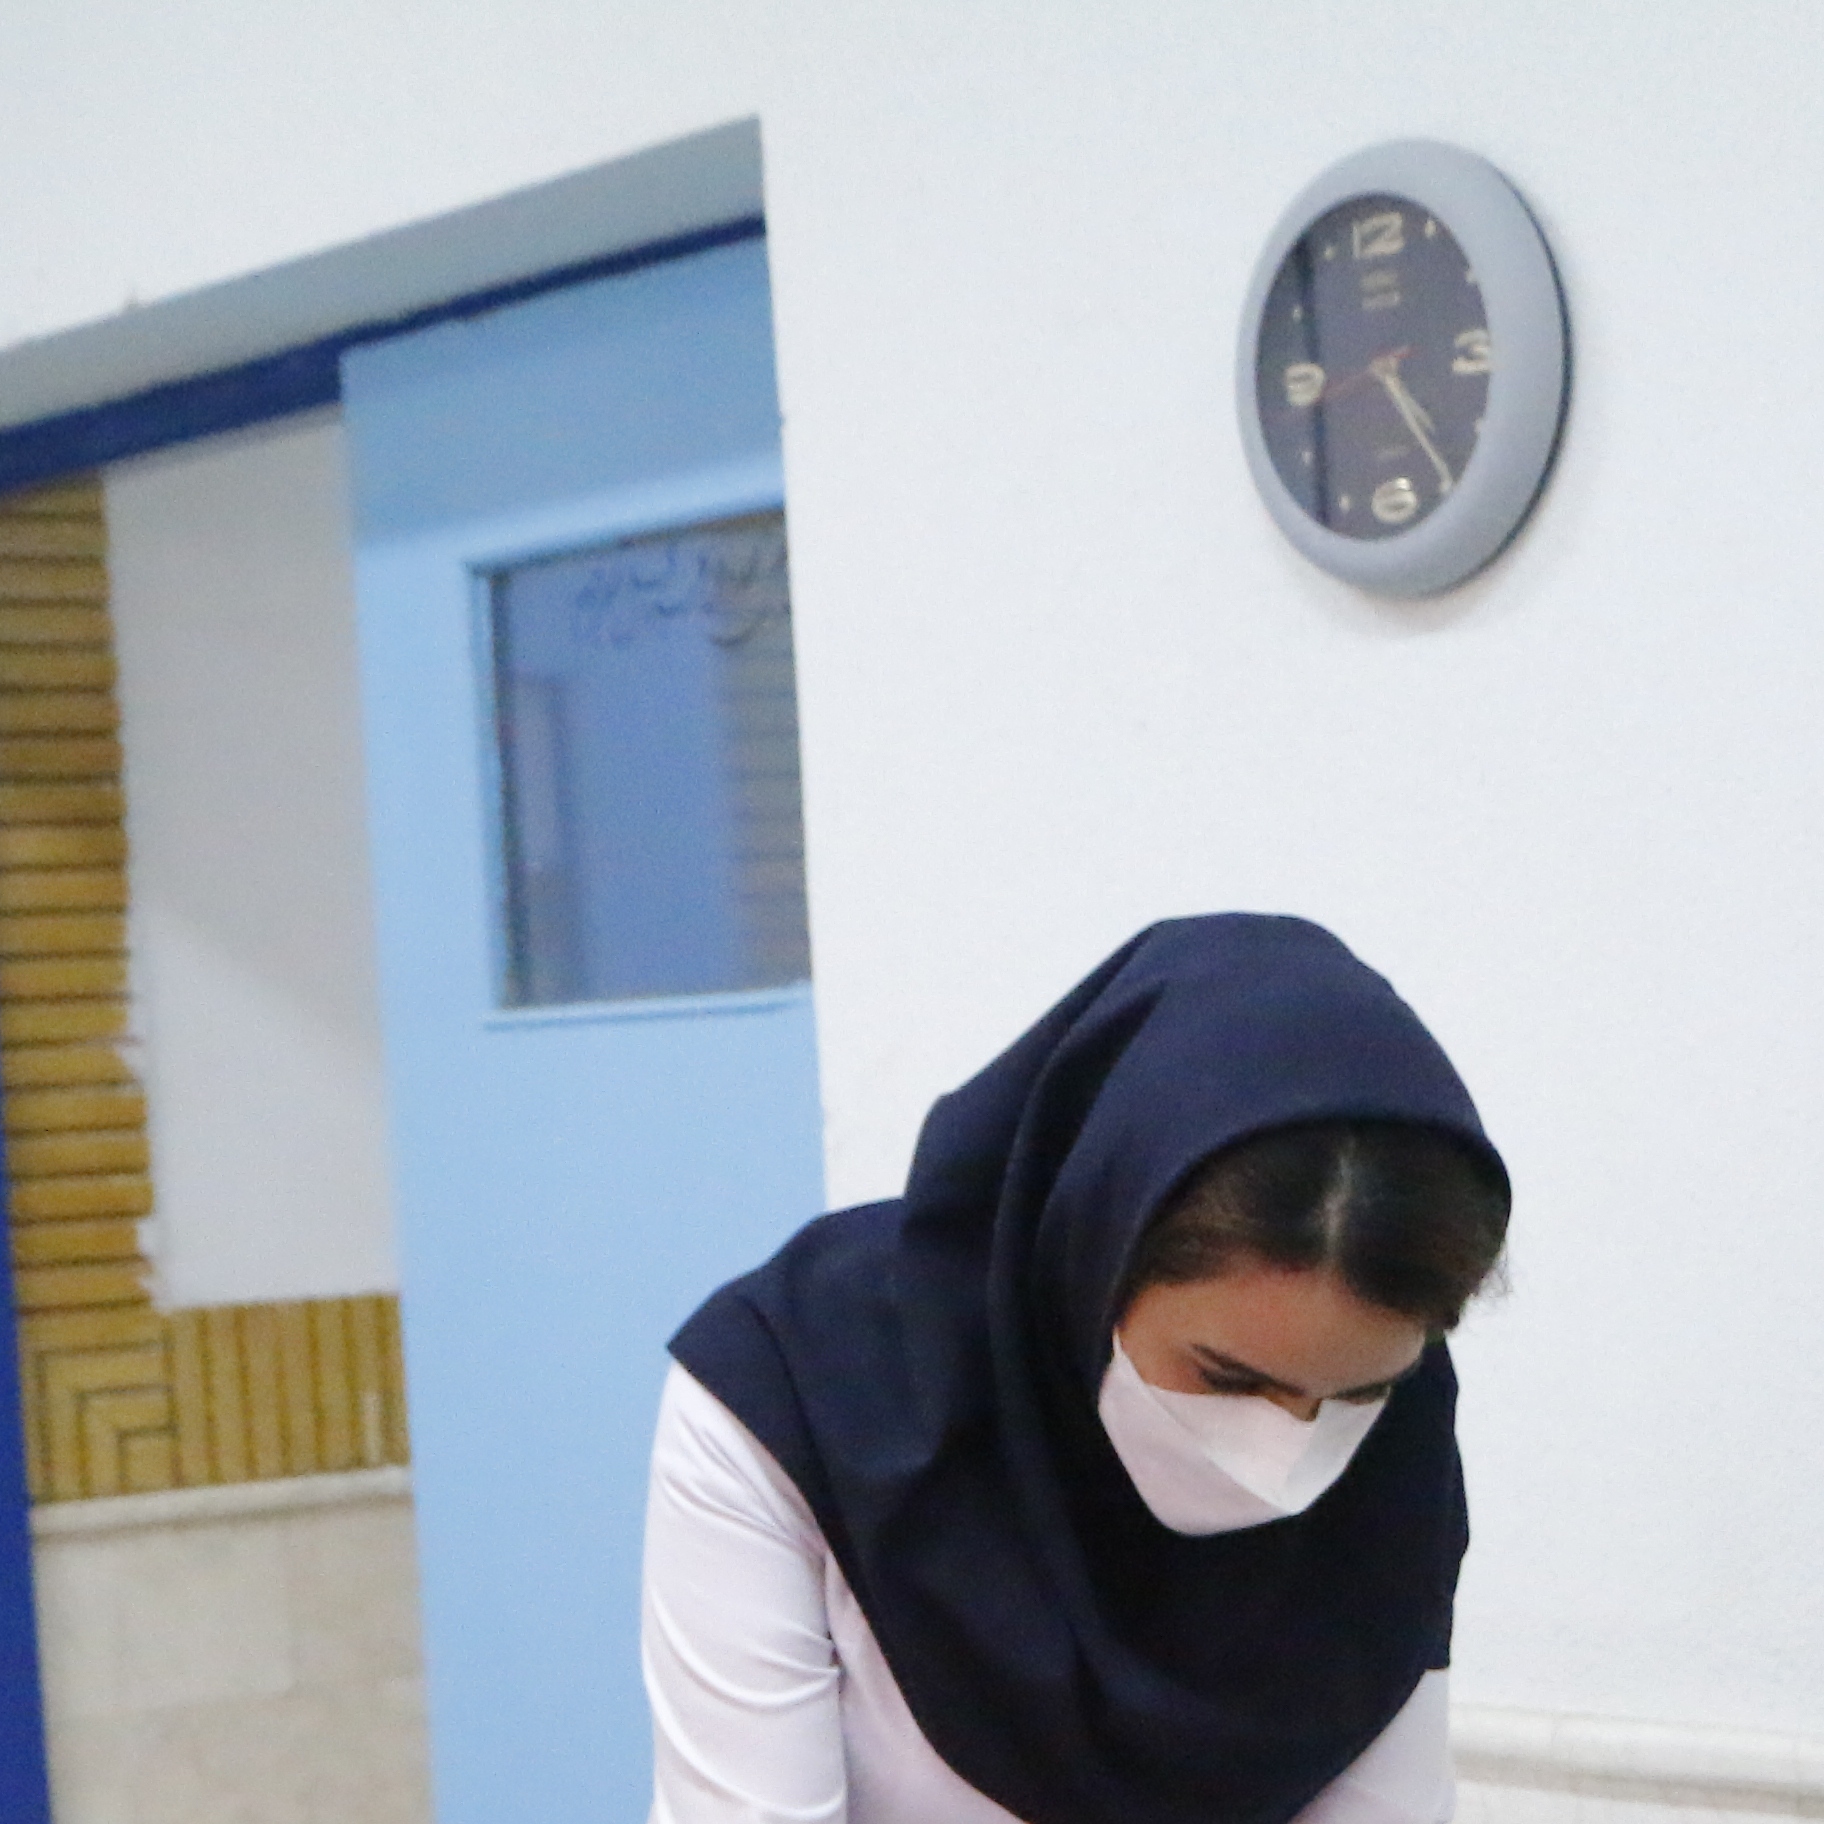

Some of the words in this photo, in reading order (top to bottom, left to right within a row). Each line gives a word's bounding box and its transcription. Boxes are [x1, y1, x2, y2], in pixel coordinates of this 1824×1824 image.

[1353, 212, 1405, 260] 12
[1452, 328, 1493, 376] 3
[1283, 362, 1326, 407] 9
[1371, 476, 1418, 524] 6
